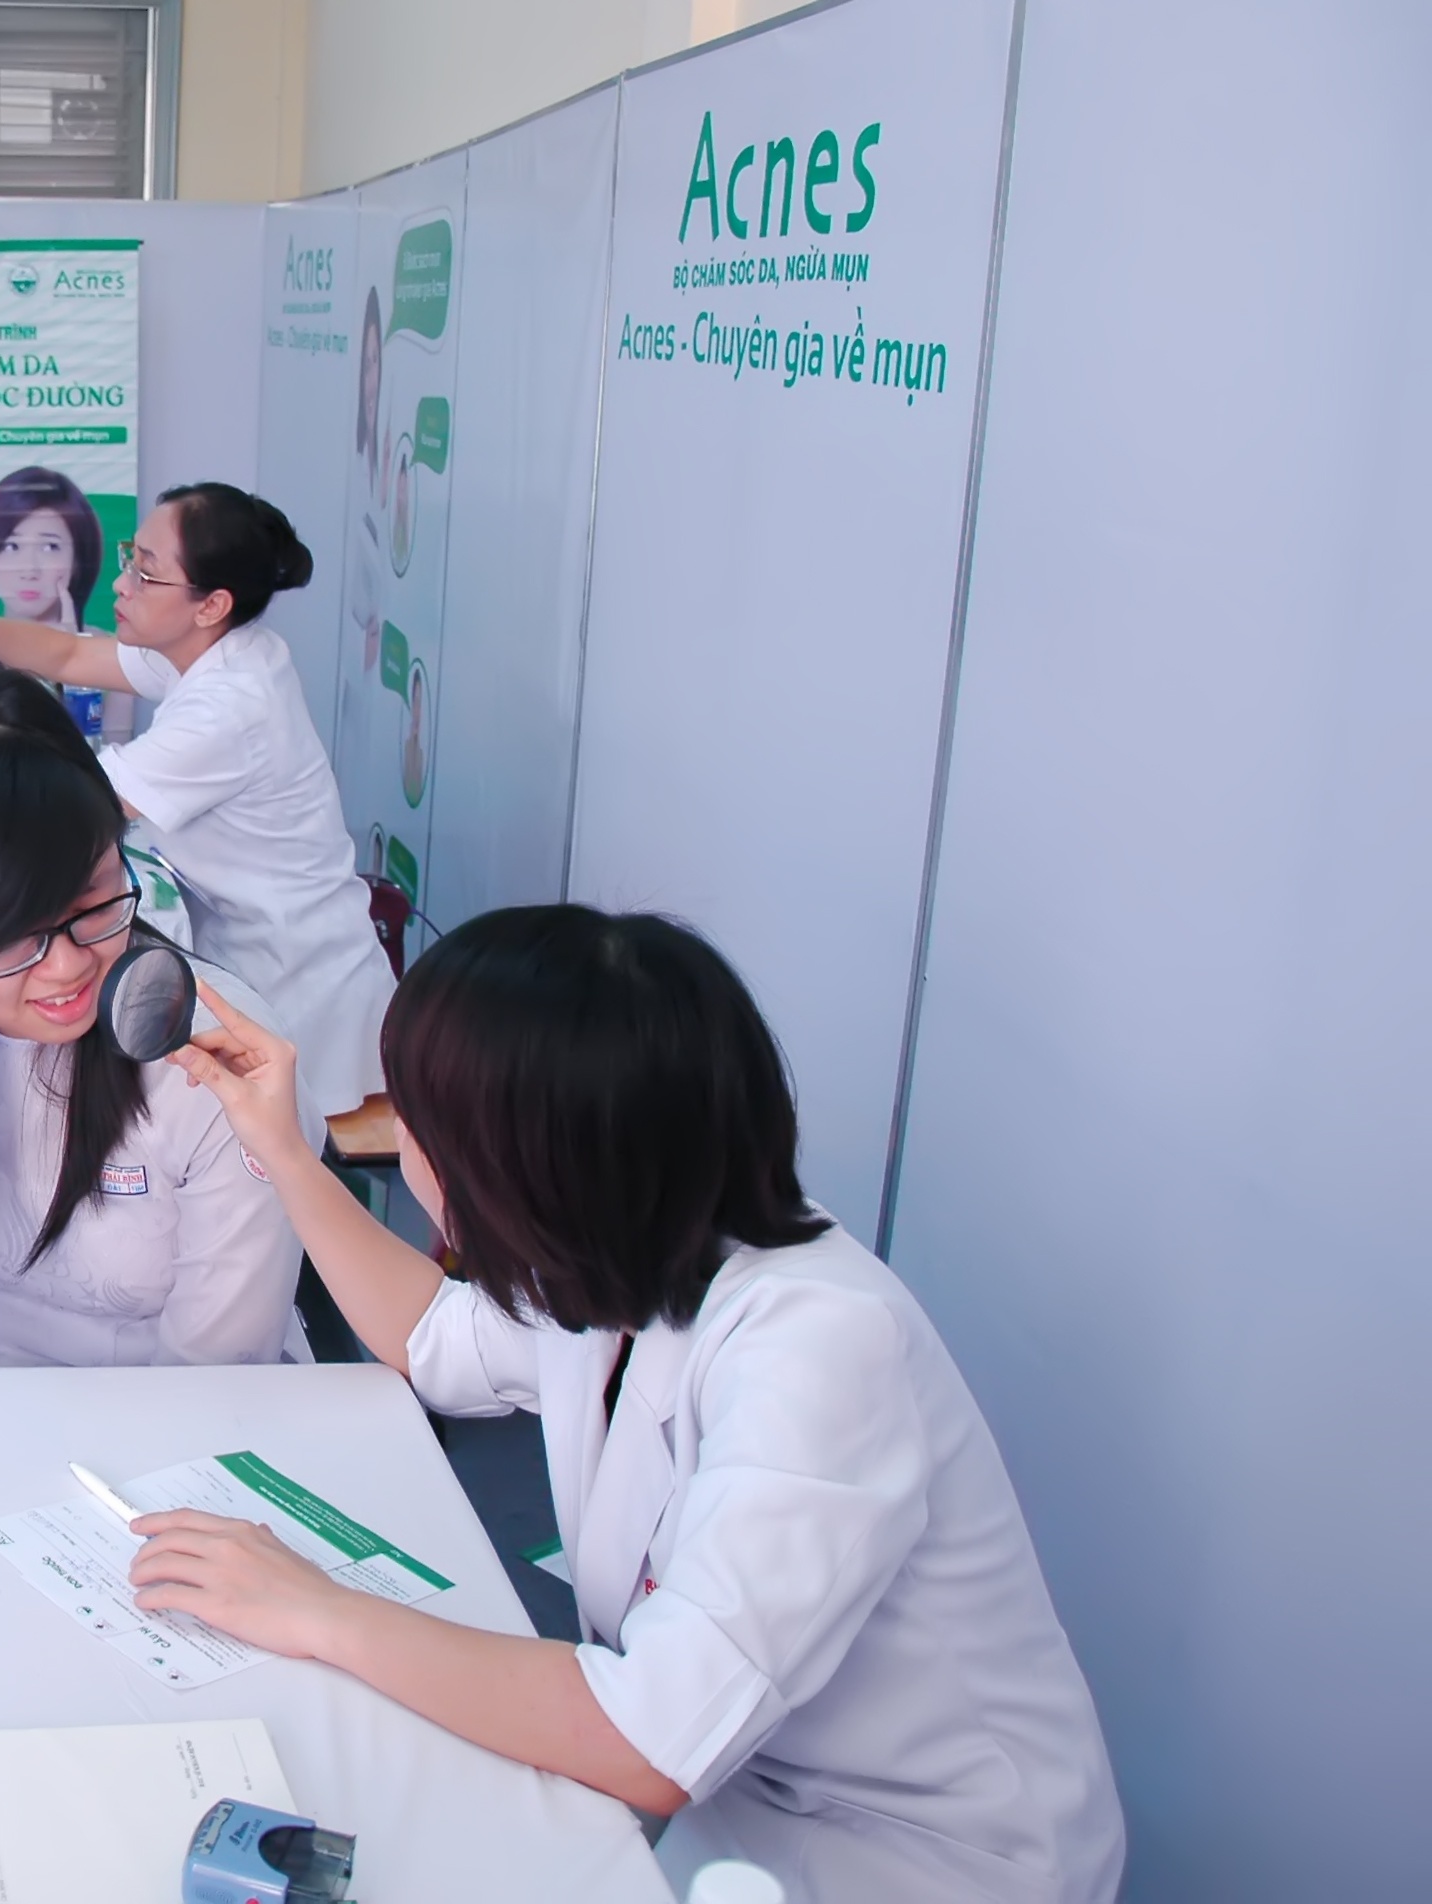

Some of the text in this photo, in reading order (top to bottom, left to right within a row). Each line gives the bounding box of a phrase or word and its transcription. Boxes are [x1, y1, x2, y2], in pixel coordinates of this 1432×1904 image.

[678, 110, 881, 245] Acnes
[53, 269, 125, 291] Acnes
[283, 232, 334, 291] Acnes
[673, 244, 871, 296] BỘ CHĂM SÓC DA, NGỪA MỤN
[23, 355, 60, 376] DA
[618, 313, 676, 362] Acnes
[692, 311, 778, 382] Chuyên
[782, 320, 825, 389] gia
[833, 306, 866, 383] về
[872, 337, 948, 407] mụn
[26, 380, 125, 408] ĐƯỜNG
